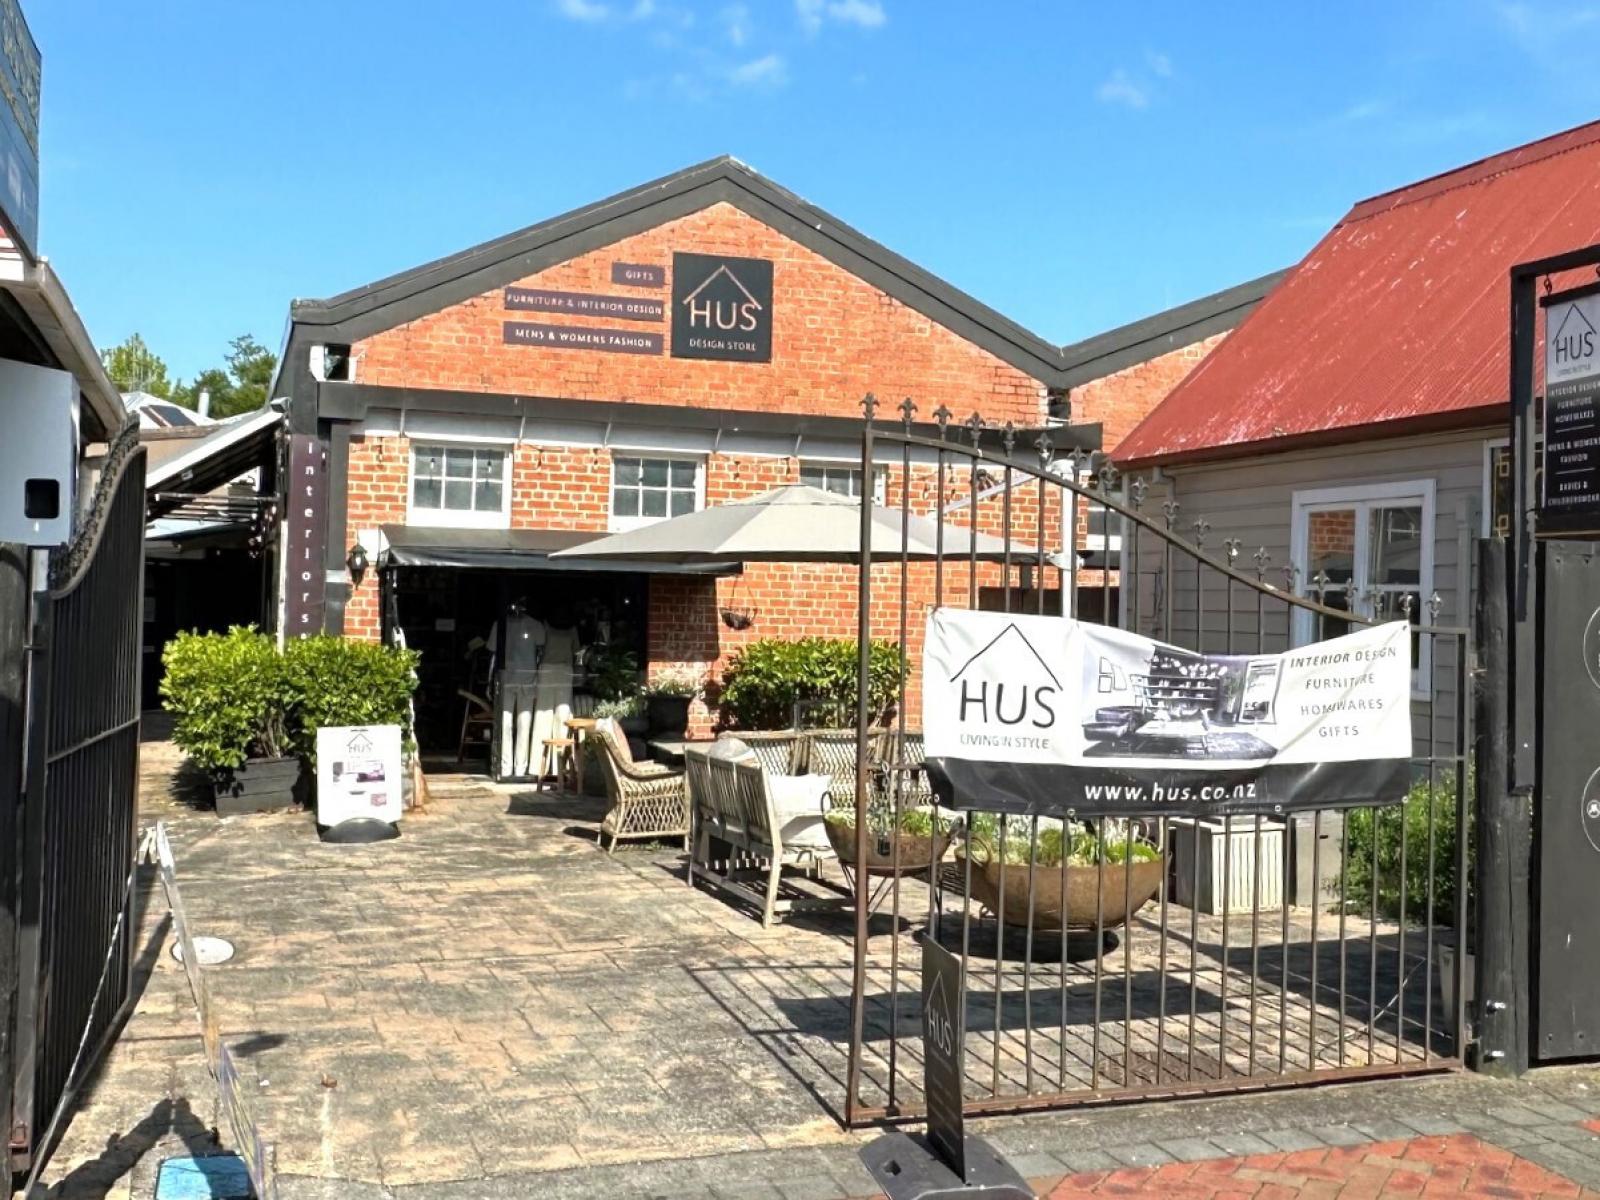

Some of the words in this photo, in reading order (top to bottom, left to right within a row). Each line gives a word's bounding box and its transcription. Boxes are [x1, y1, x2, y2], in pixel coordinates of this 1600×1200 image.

[625, 270, 654, 281] GIFTS
[507, 293, 563, 306] FURNITURE
[566, 299, 574, 307] &
[577, 300, 623, 313] INTERIOR
[626, 304, 662, 315] DESIGN
[690, 298, 757, 331] HUS
[515, 328, 544, 340] MENS
[548, 331, 555, 341] &
[559, 332, 606, 344] WOMENS
[609, 336, 652, 348] FASHION
[689, 338, 725, 350] DESIGN
[727, 341, 756, 352] STORE
[1555, 331, 1594, 364] HUS
[1290, 653, 1350, 669] INTERIOR
[1355, 647, 1397, 662] DESGN
[1305, 673, 1375, 690] FURNITURE
[959, 679, 1056, 729] HUS
[960, 733, 1000, 747] LIVING
[1014, 736, 1050, 750] STYLE
[1318, 725, 1360, 738] GIFTS
[1084, 781, 1257, 801] www.hus.co.nz
[928, 1008, 953, 1056] HUS
